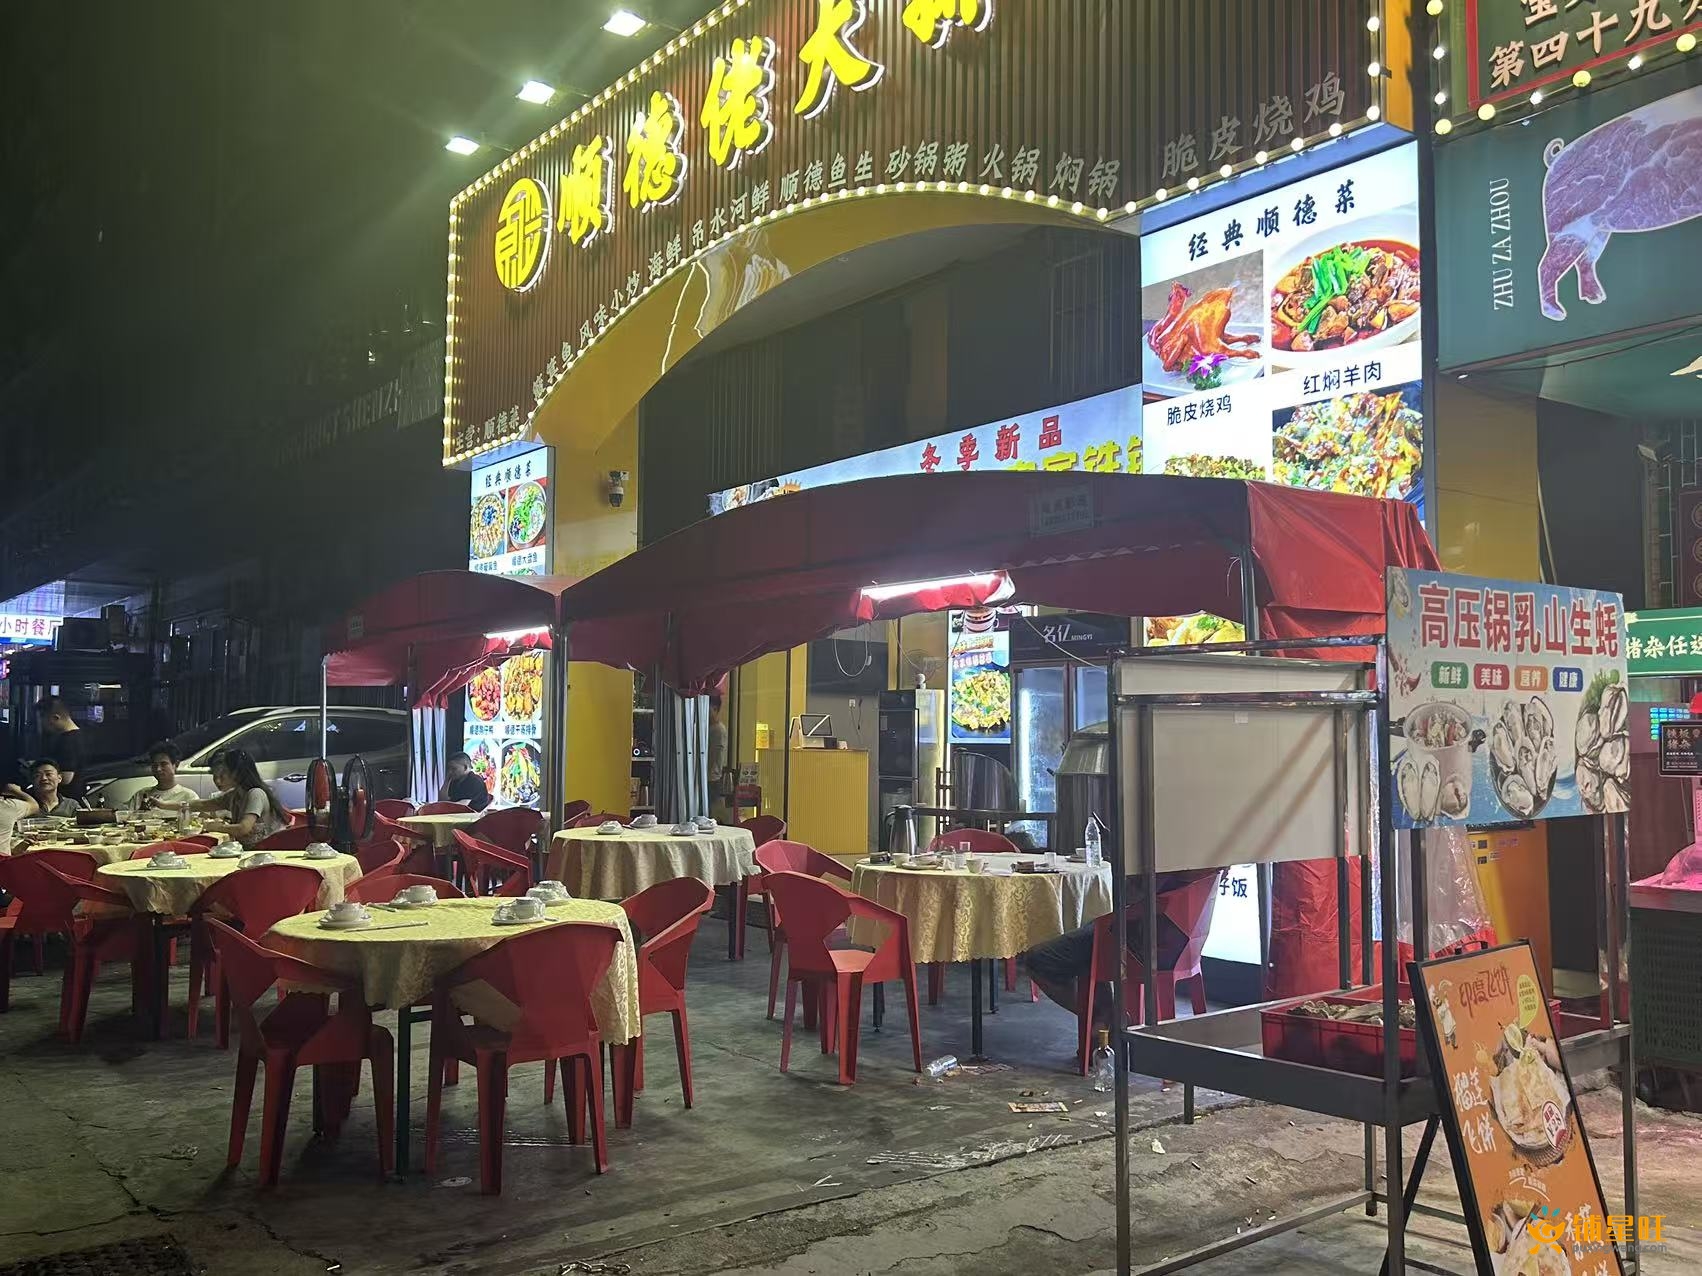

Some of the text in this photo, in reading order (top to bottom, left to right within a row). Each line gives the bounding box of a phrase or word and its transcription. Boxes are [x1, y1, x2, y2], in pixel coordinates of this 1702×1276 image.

[579, 269, 641, 348] 风味小炒
[647, 233, 682, 281] 海鲜
[691, 180, 770, 248] 吊水河鲜
[779, 150, 873, 204] 顺德鱼生
[884, 139, 970, 181] 砂锅粥
[979, 143, 1041, 186] 火锅
[1049, 151, 1121, 199] 焖锅
[1161, 71, 1346, 179] 脆皮烧鸡
[1188, 179, 1357, 262] 经典顺德菜
[1489, 178, 1514, 311] ZHU ZA ZHOU
[1303, 361, 1383, 396] 红焖羊肉
[1167, 394, 1233, 427] 脆皮烧鸡
[920, 414, 1062, 473] 冬季新品
[485, 460, 531, 488] 经典顺德菜
[1043, 624, 1070, 643] 名亿
[1418, 581, 1619, 658] 高压锅乳山生蚝
[1438, 665, 1578, 689] 新鲜 美味 营养 健康
